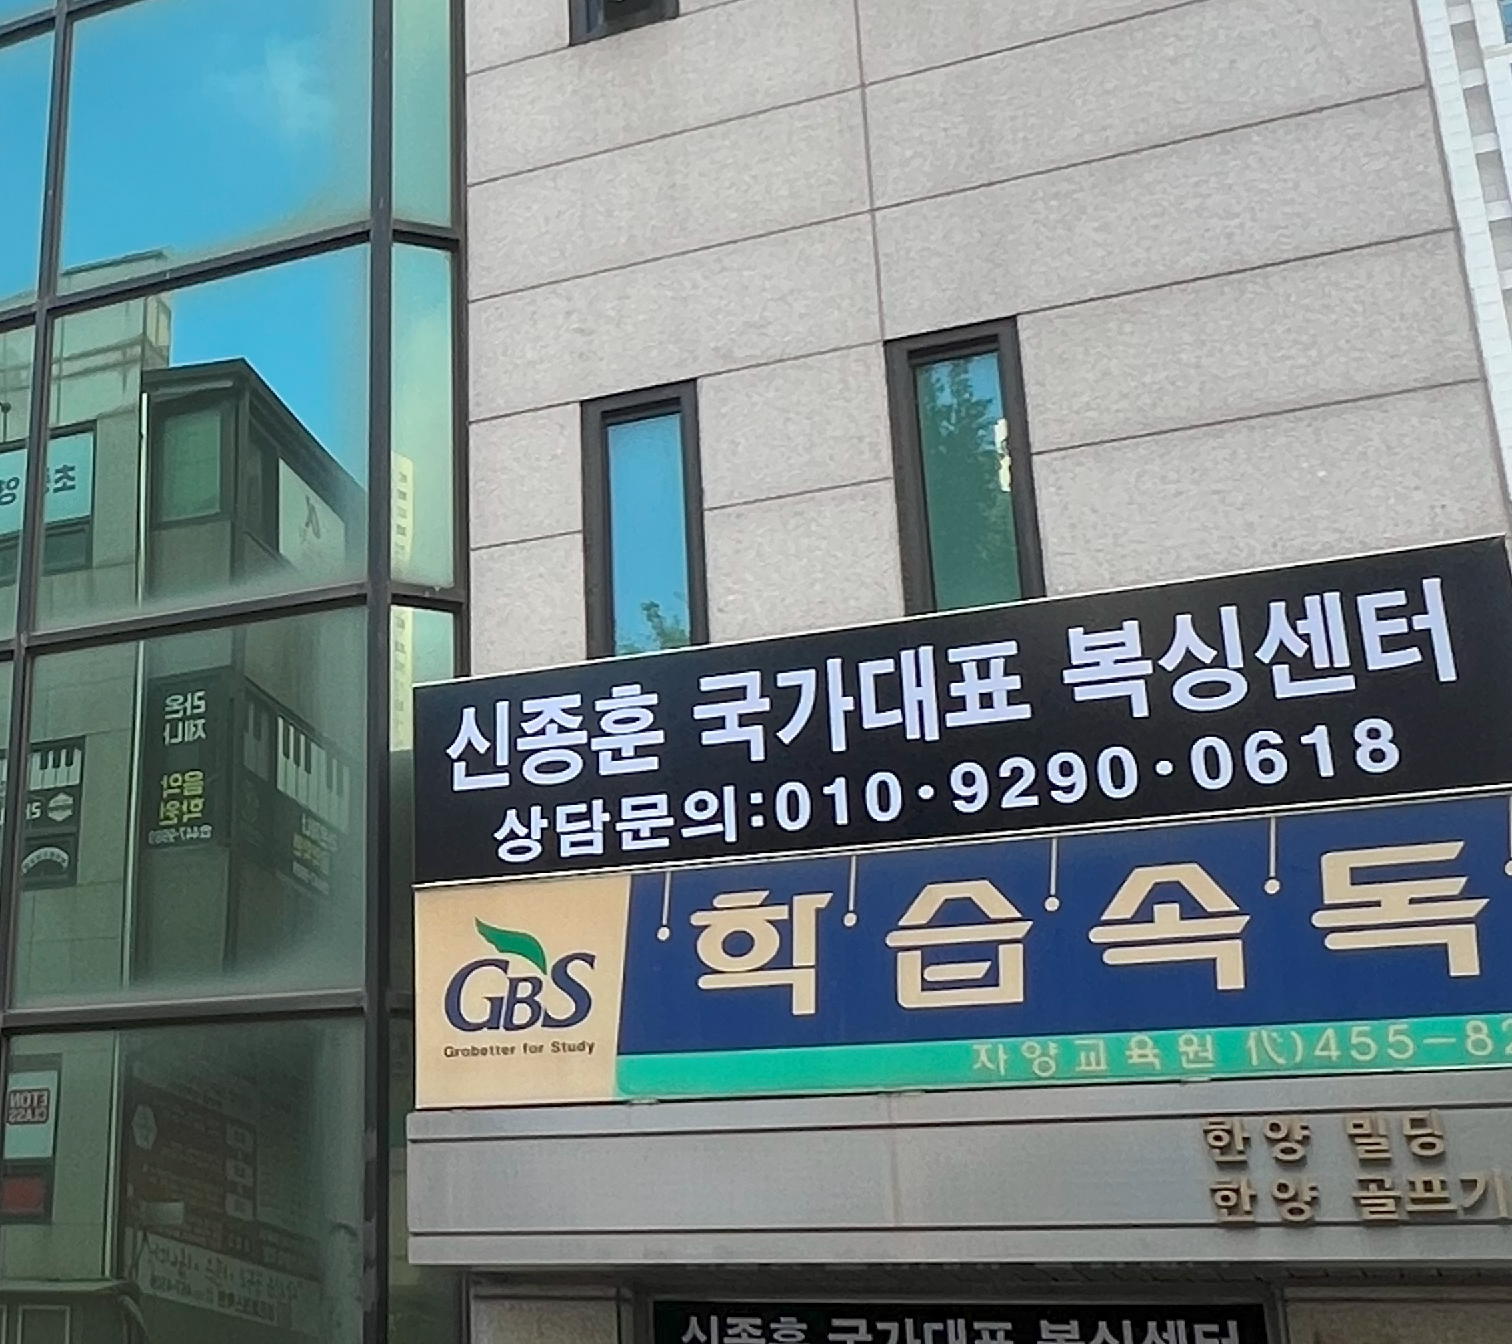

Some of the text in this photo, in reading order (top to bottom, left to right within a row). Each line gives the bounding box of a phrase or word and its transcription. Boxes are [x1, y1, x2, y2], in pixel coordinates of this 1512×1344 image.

[445, 575, 1458, 792] 신종훈 국가대표 복싱센터
[689, 840, 1490, 1016] 학습속독
[443, 951, 597, 1033] GBS
[522, 1041, 545, 1055] for
[550, 1040, 596, 1057] Study
[971, 1032, 1217, 1080] 자양교육원
[1202, 1116, 1311, 1164] 한양
[1209, 1176, 1320, 1223] 한양
